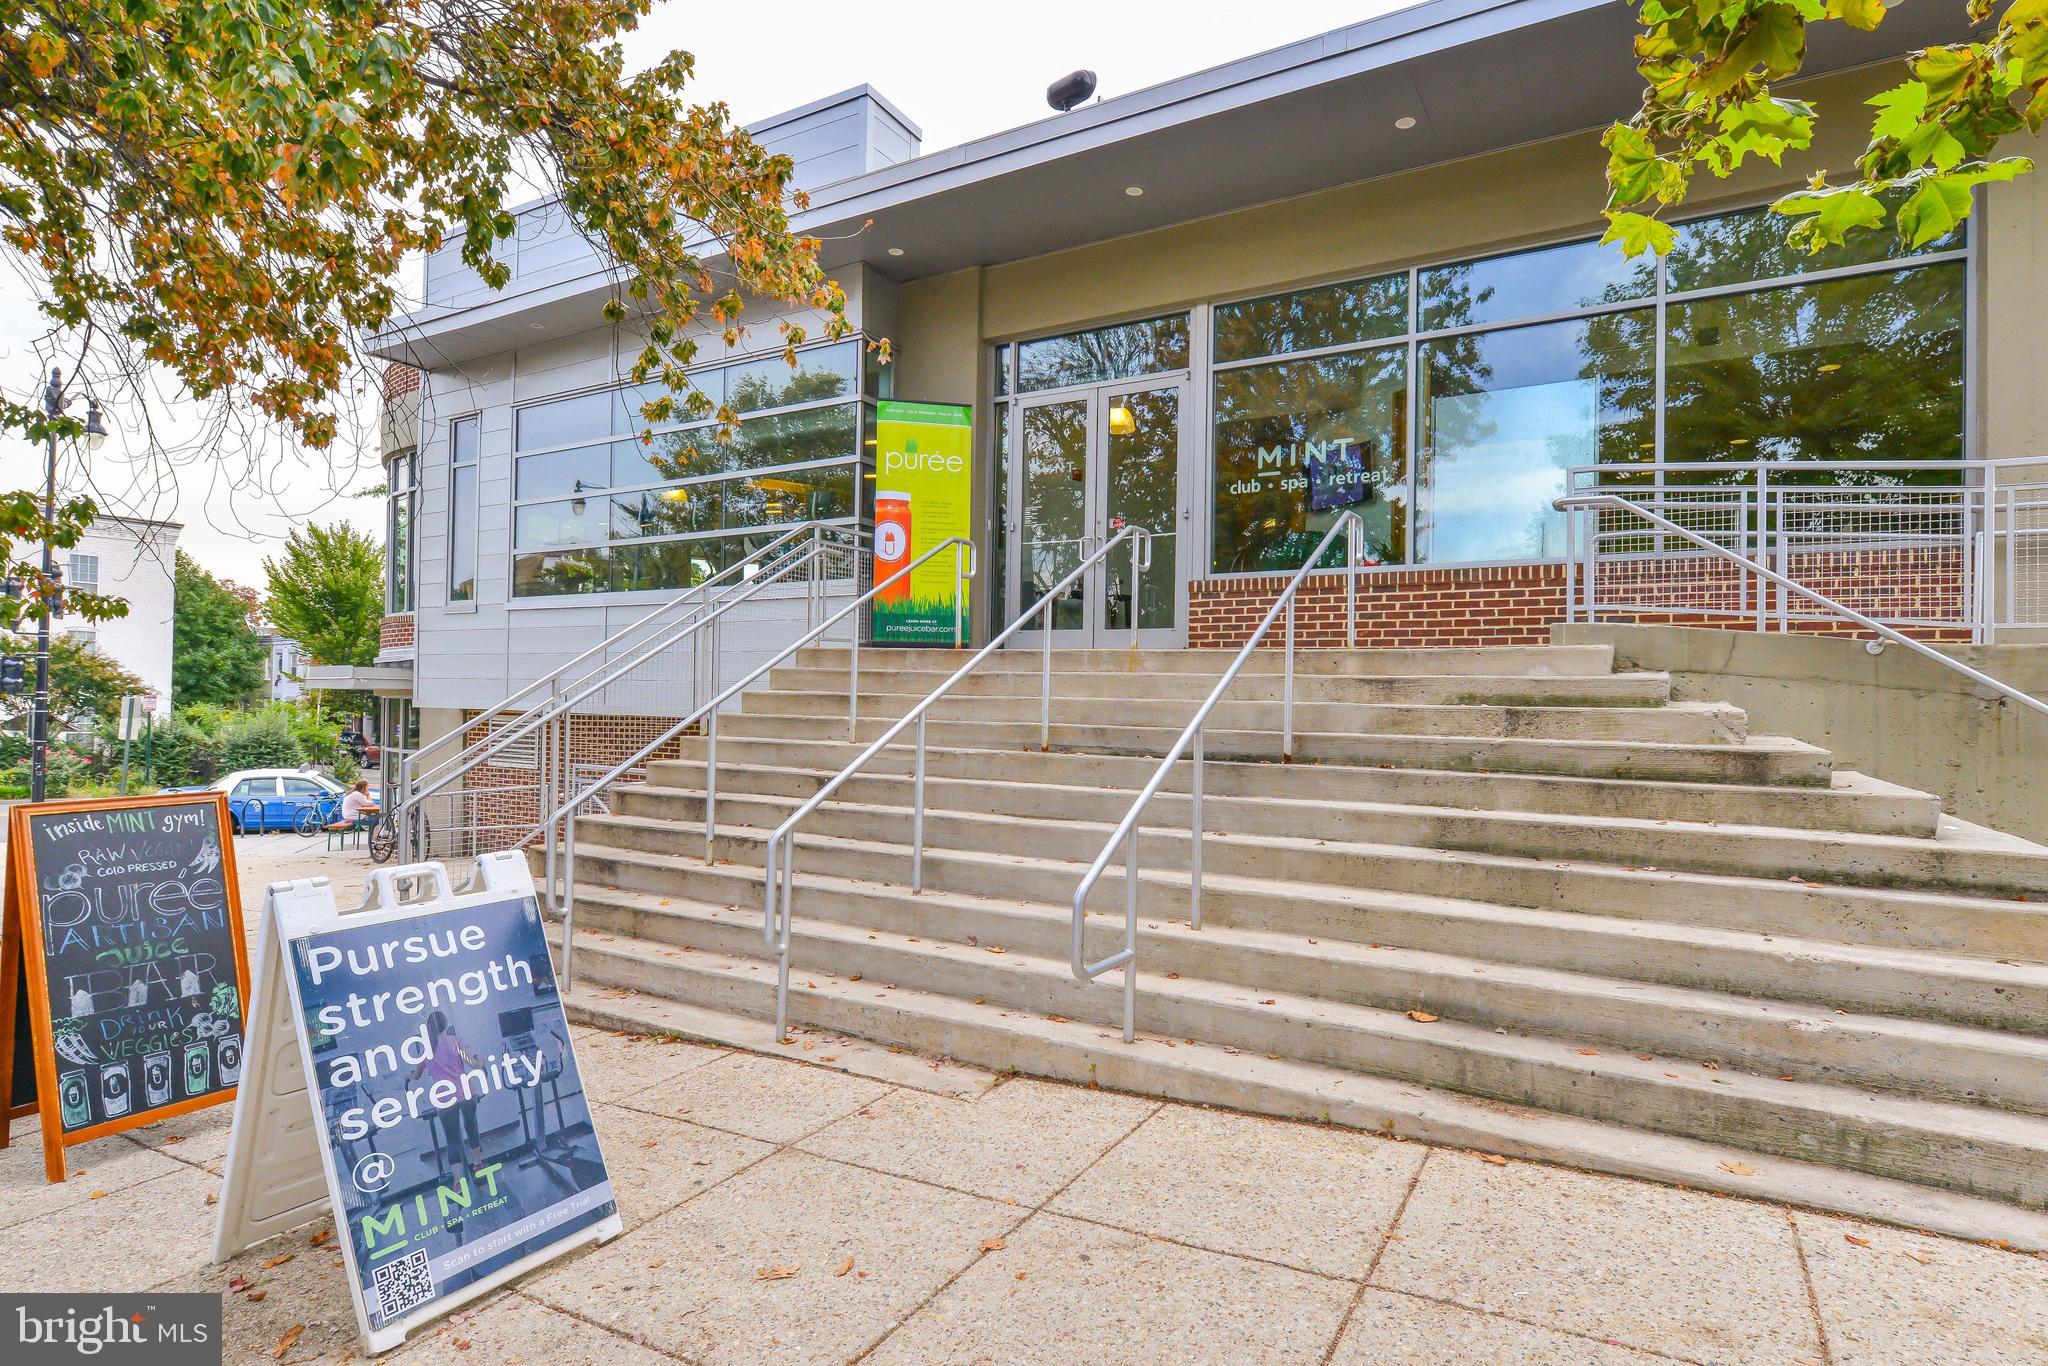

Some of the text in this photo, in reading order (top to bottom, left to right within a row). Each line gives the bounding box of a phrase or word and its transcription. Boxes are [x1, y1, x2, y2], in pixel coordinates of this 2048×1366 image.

[1257, 437, 1354, 470] MINT
[1230, 466, 1388, 495] club spa retreat
[885, 624, 956, 633] pureejuicebar.com
[42, 808, 205, 842] inside MINT gym!
[78, 844, 127, 865] RAW
[127, 860, 177, 873] PRESSED
[59, 907, 225, 955] ARTISAN
[308, 925, 486, 986] Pursue
[64, 952, 219, 1019] BAR
[318, 954, 534, 1036] strength
[329, 1023, 434, 1089] and
[340, 1049, 543, 1141] serenity
[352, 1152, 395, 1193] @
[361, 1162, 503, 1250] MINT
[414, 1195, 509, 1243] CLUB SPA RETREAT
[443, 1195, 592, 1271] Scan to start with a Free Trial
